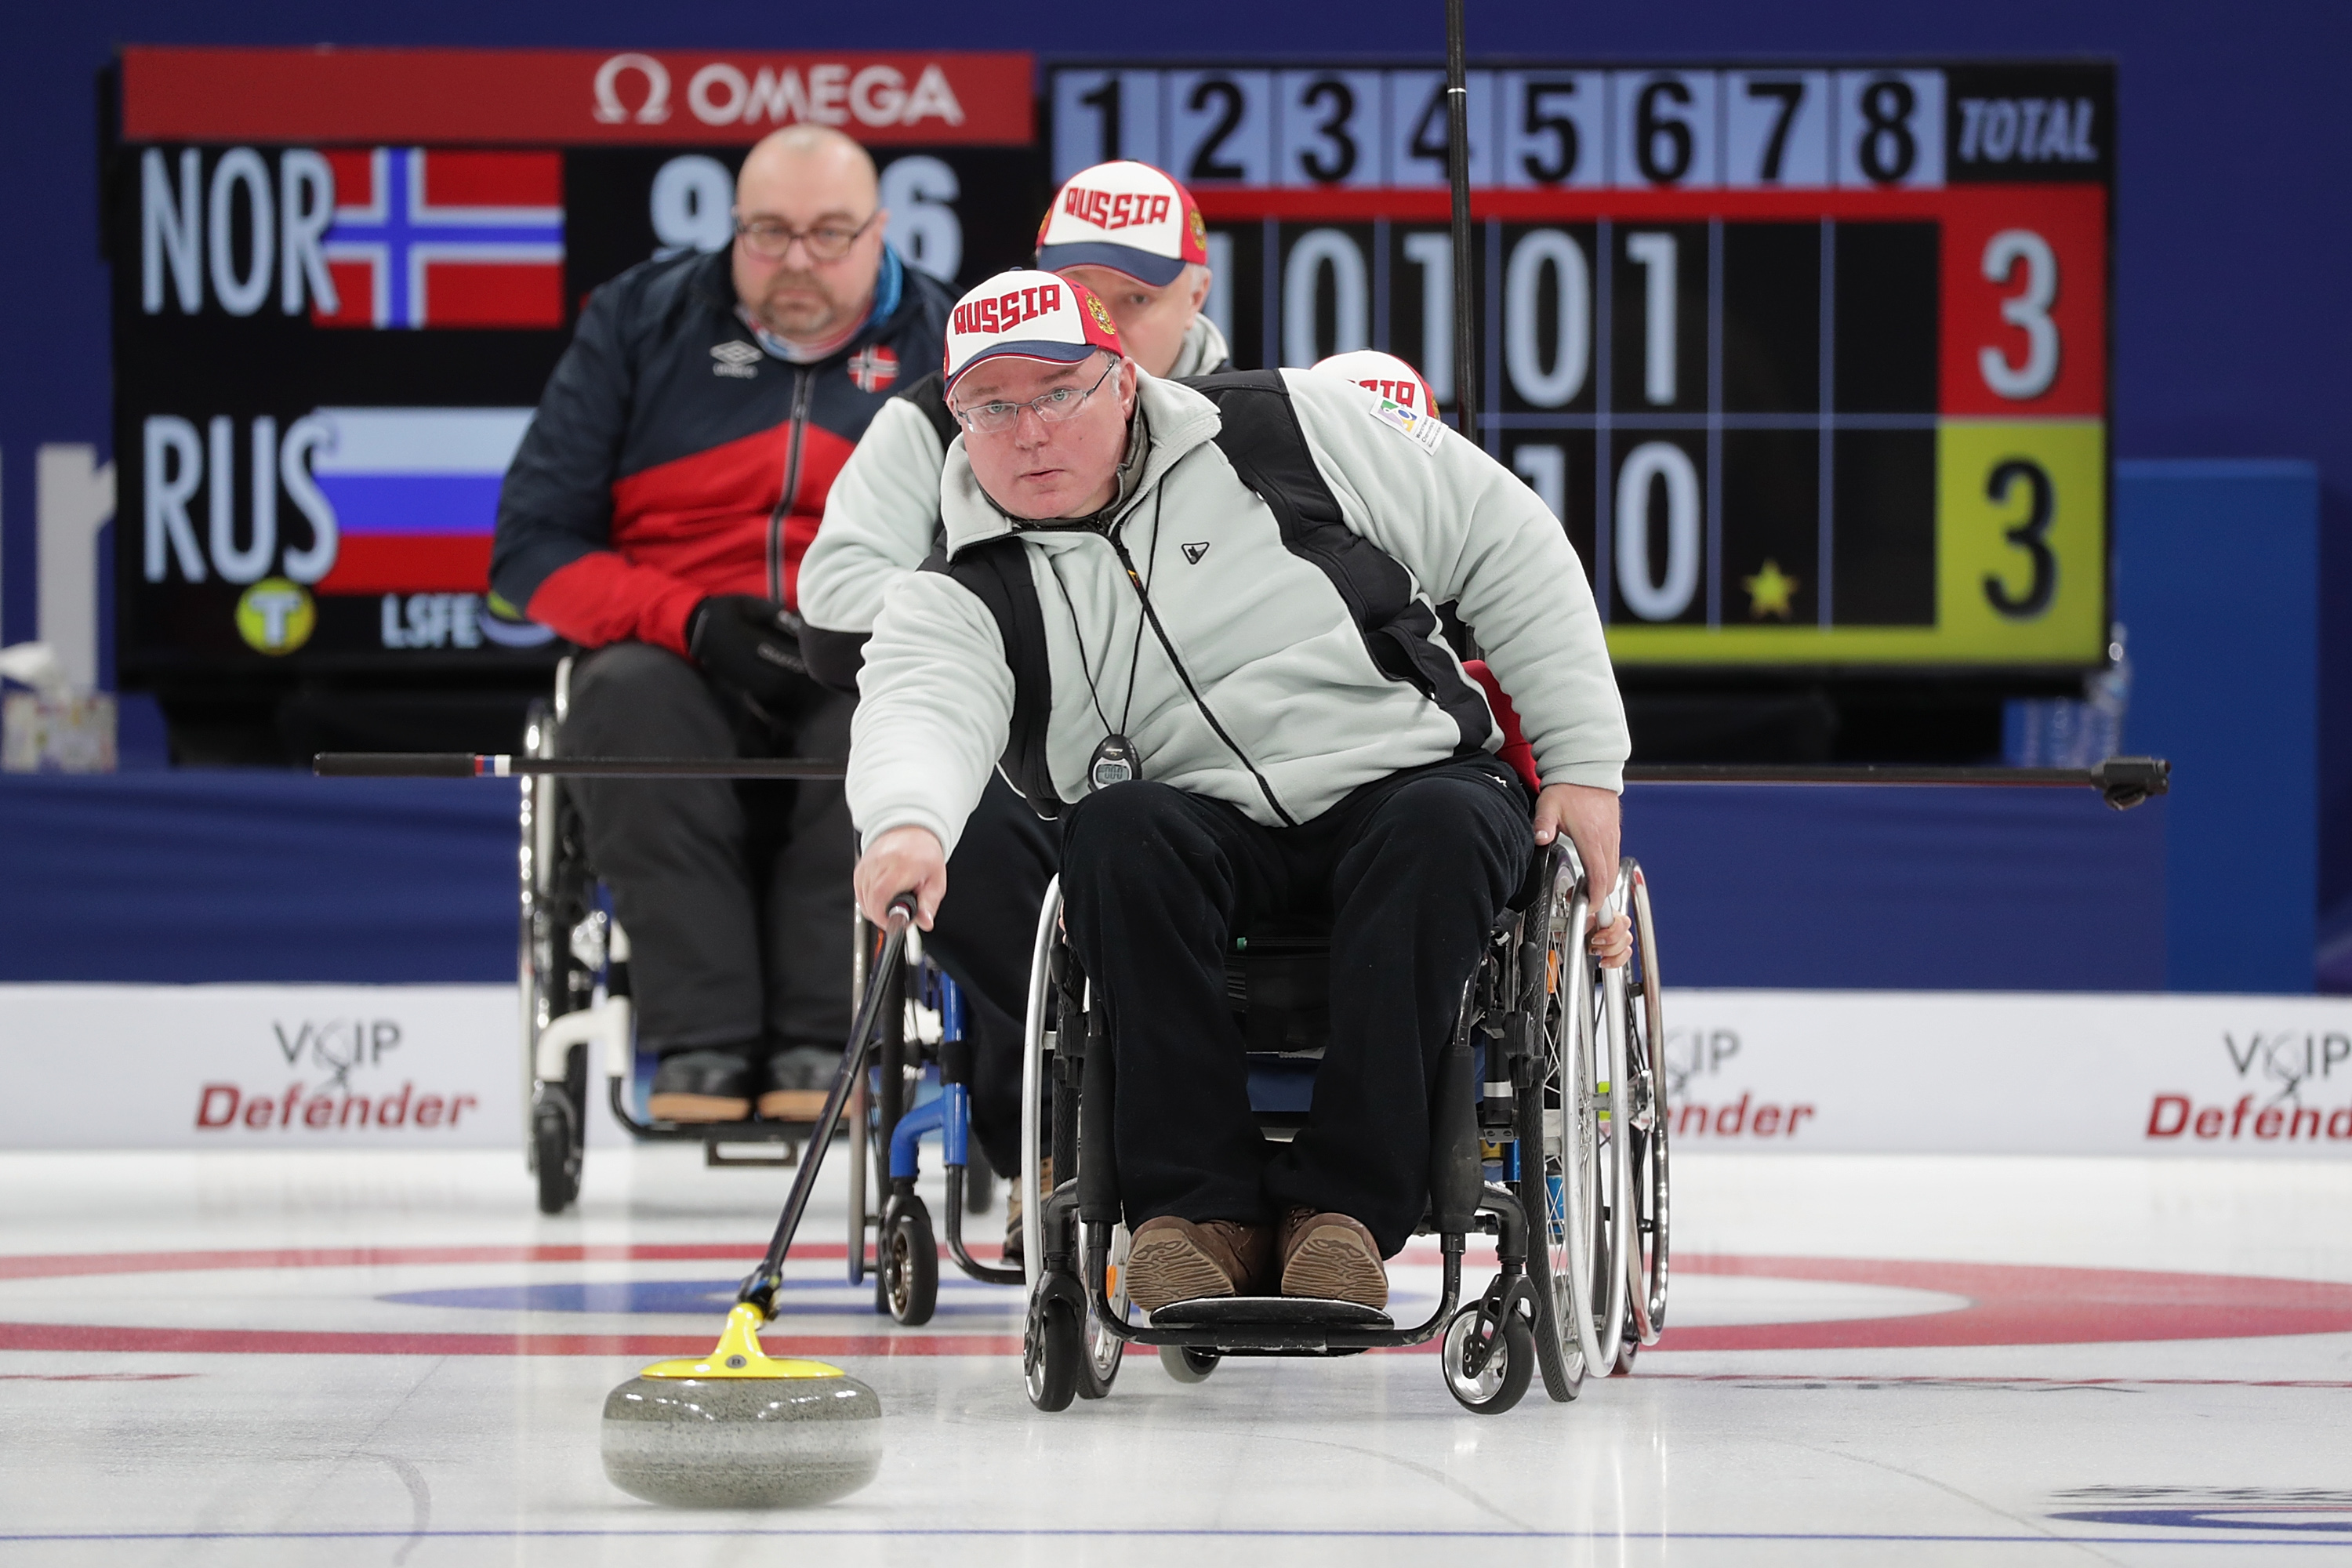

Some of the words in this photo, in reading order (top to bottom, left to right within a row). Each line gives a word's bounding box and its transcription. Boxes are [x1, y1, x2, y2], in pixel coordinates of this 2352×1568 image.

[687, 63, 965, 127] OMEGA
[1080, 79, 1123, 162] 1
[1189, 81, 1249, 180] 2
[1300, 82, 1358, 182] 3
[1409, 81, 1472, 180] 4
[1521, 82, 1580, 182] 5
[1635, 82, 1692, 181] 6
[1747, 82, 1808, 180] 7
[1858, 82, 1918, 181] 8
[1960, 97, 2098, 162] TOTAL
[141, 147, 339, 315] NOR
[1064, 187, 1171, 230] RUSSIA
[953, 284, 1061, 336] RUSSIA
[1283, 229, 1369, 372] 0
[1403, 234, 1454, 405] 1
[1504, 229, 1592, 408] 0
[1626, 233, 1677, 405] 1
[1977, 228, 2060, 401] 3
[143, 414, 339, 584] RUS
[1614, 441, 1701, 621] 0
[1981, 455, 2057, 619] 3
[250, 591, 301, 646] T
[195, 1080, 477, 1130] Defender
